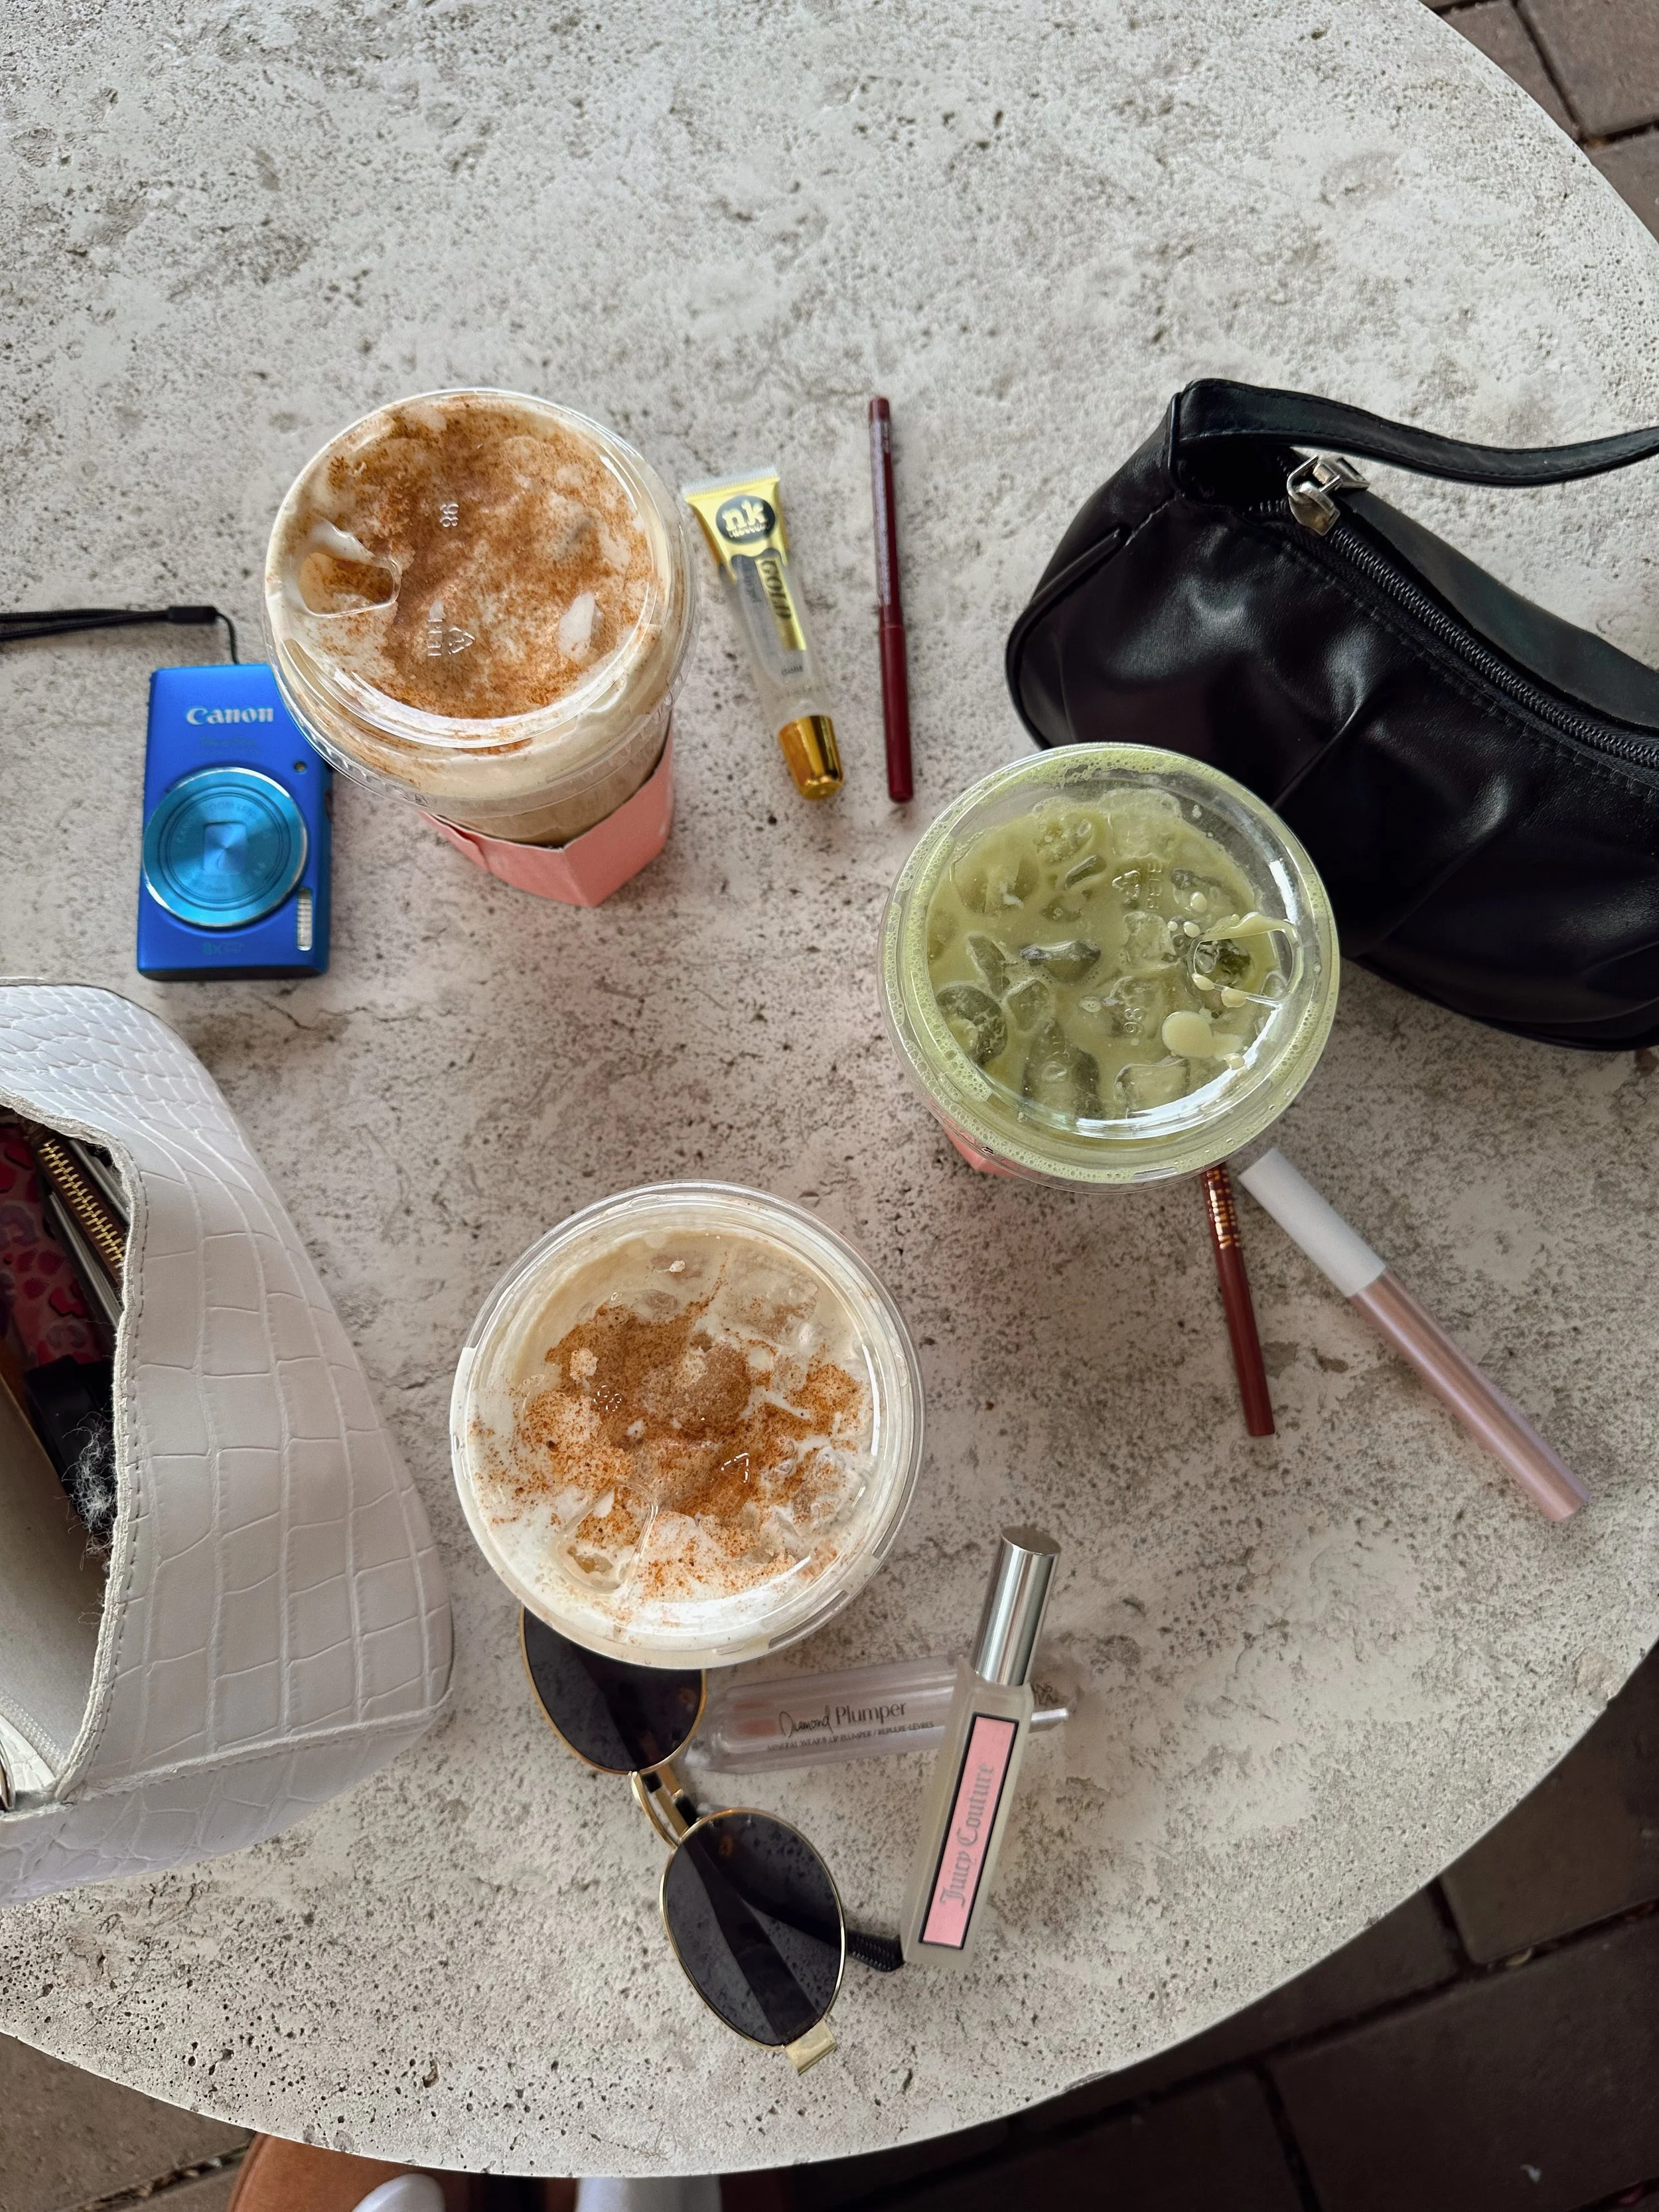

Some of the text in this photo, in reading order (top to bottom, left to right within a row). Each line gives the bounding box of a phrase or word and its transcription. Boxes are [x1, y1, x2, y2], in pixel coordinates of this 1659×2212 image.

[721, 499, 767, 532] nk
[186, 707, 273, 725] Canon
[778, 1702, 906, 1738] Diamond Plumper
[939, 1763, 994, 1907] Juicy Couture
